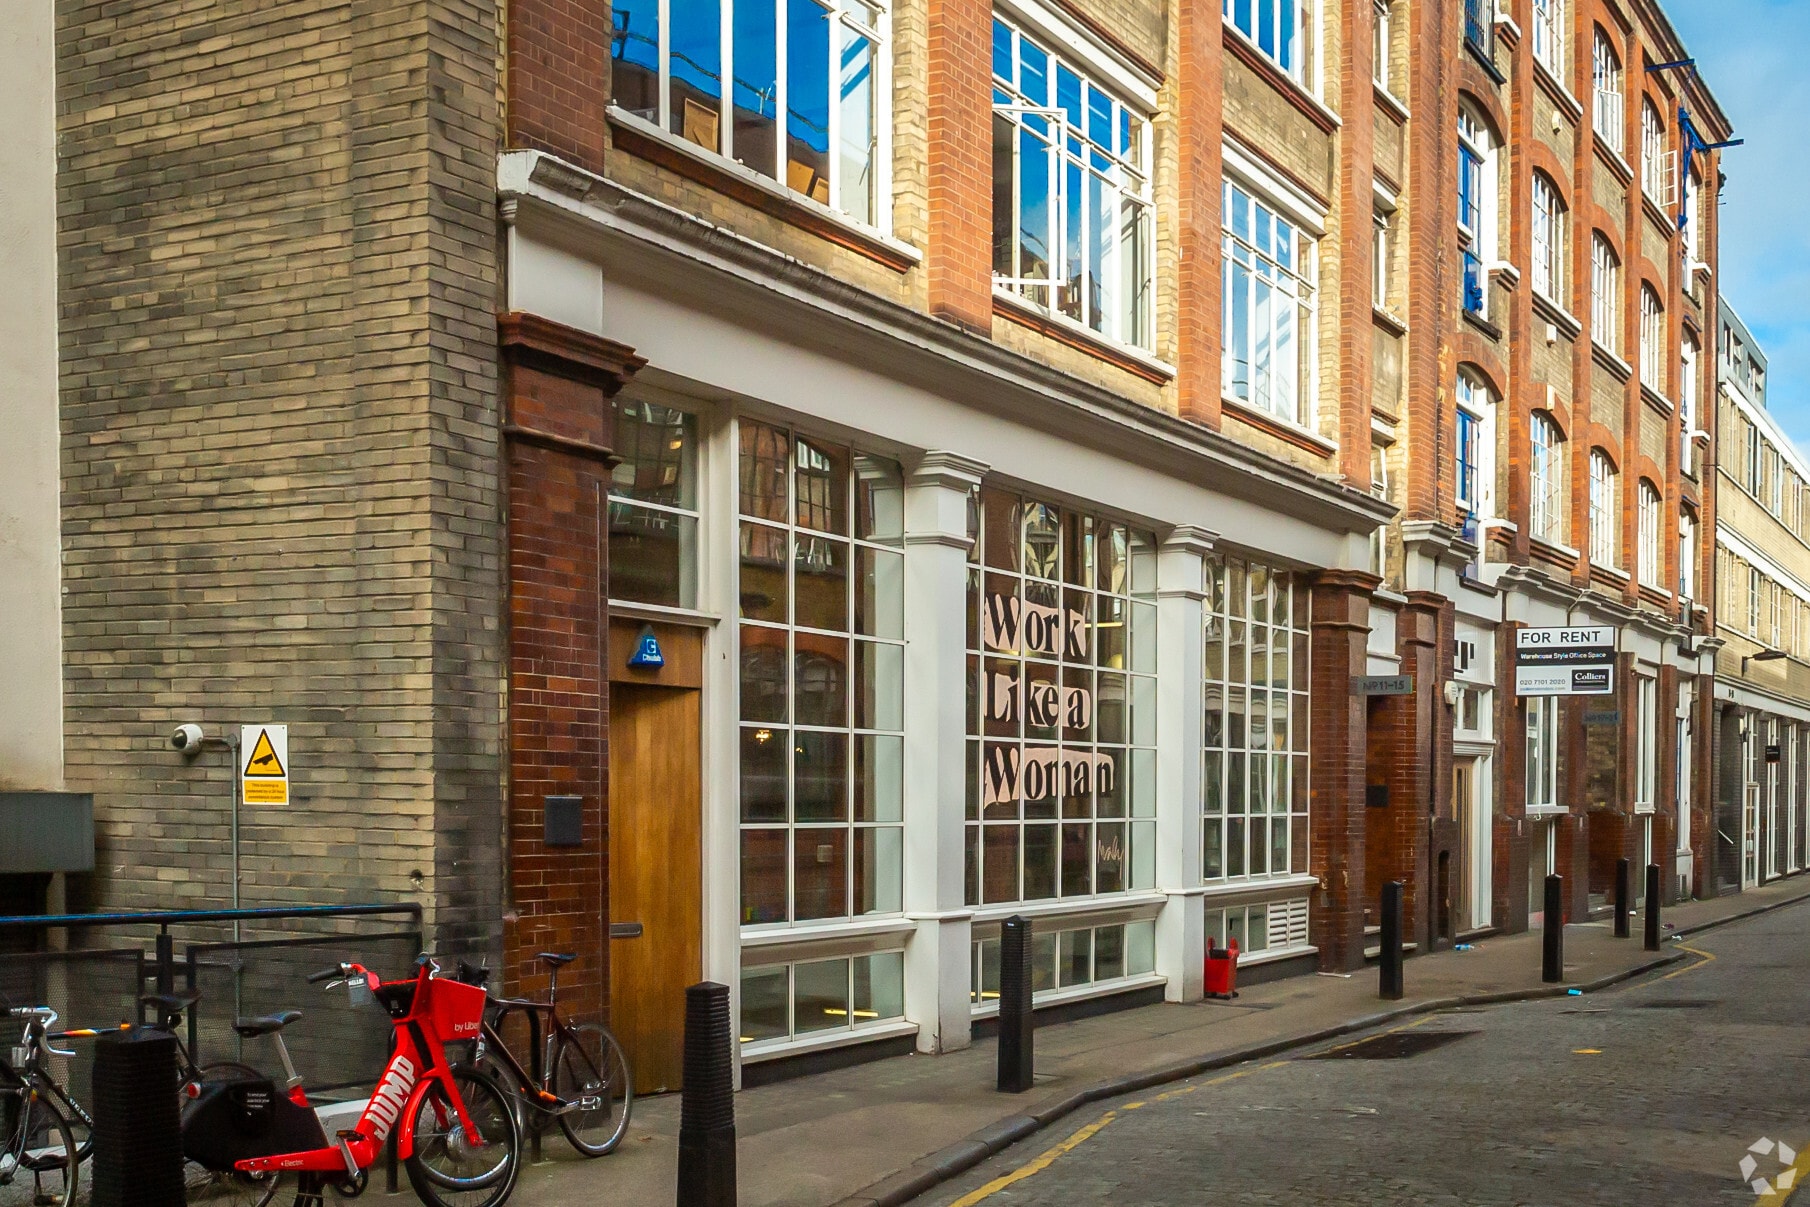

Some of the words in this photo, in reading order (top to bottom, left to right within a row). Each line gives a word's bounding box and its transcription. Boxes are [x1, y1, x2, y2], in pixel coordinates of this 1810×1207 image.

[984, 593, 1086, 657] Work
[1521, 632, 1551, 643] FOR
[1561, 631, 1600, 642] RENT
[984, 665, 1058, 727] Like
[1067, 688, 1086, 729] a
[984, 747, 1115, 801] Woman
[454, 1023, 464, 1033] by
[366, 1055, 415, 1141] JUMP
